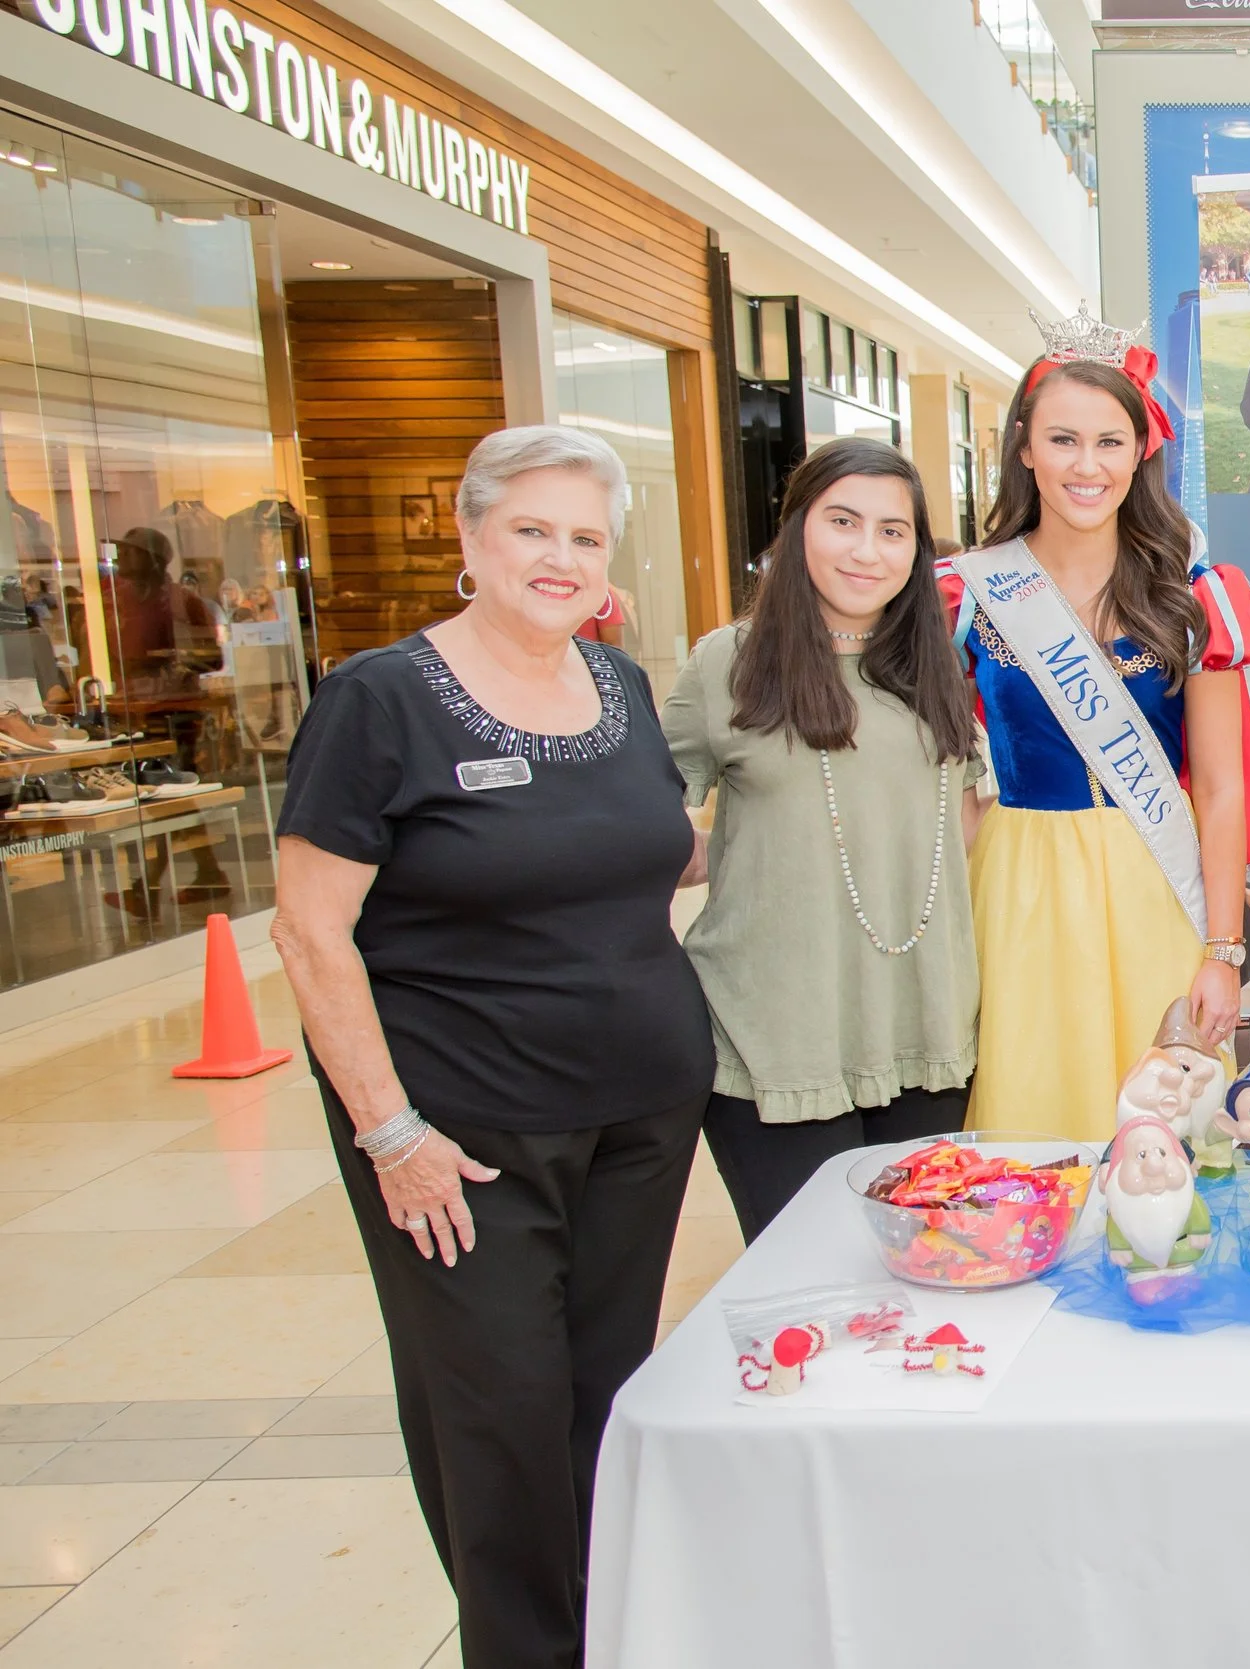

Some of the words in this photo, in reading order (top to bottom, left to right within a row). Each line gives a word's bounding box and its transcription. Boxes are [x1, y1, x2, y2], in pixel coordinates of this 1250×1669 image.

[382, 93, 530, 236] MURPHY
[985, 570, 1021, 590] Miss
[988, 571, 1041, 604] America
[1015, 578, 1048, 603] 2018
[1037, 633, 1110, 722] MISS
[1098, 719, 1173, 826] TEXAS
[0, 841, 37, 861] NSTON
